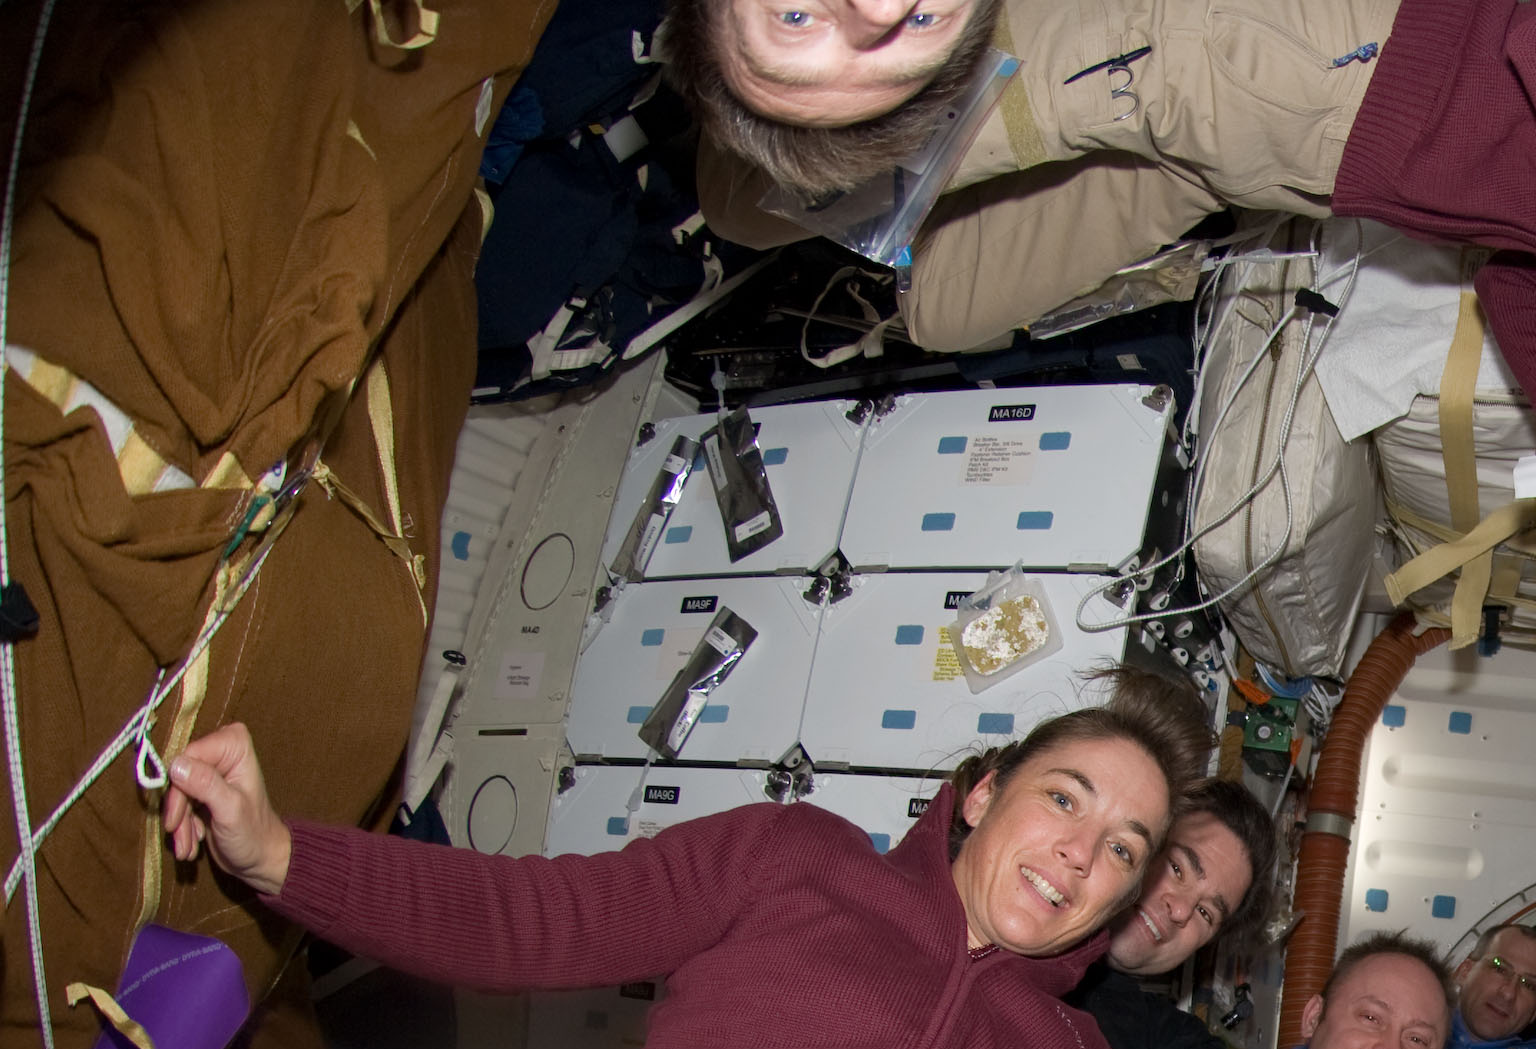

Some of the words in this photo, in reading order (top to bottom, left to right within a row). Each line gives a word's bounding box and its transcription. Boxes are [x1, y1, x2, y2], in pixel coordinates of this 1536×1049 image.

[993, 407, 1031, 418] MA16D
[687, 599, 712, 610] MA9F
[649, 789, 675, 801] MA9G
